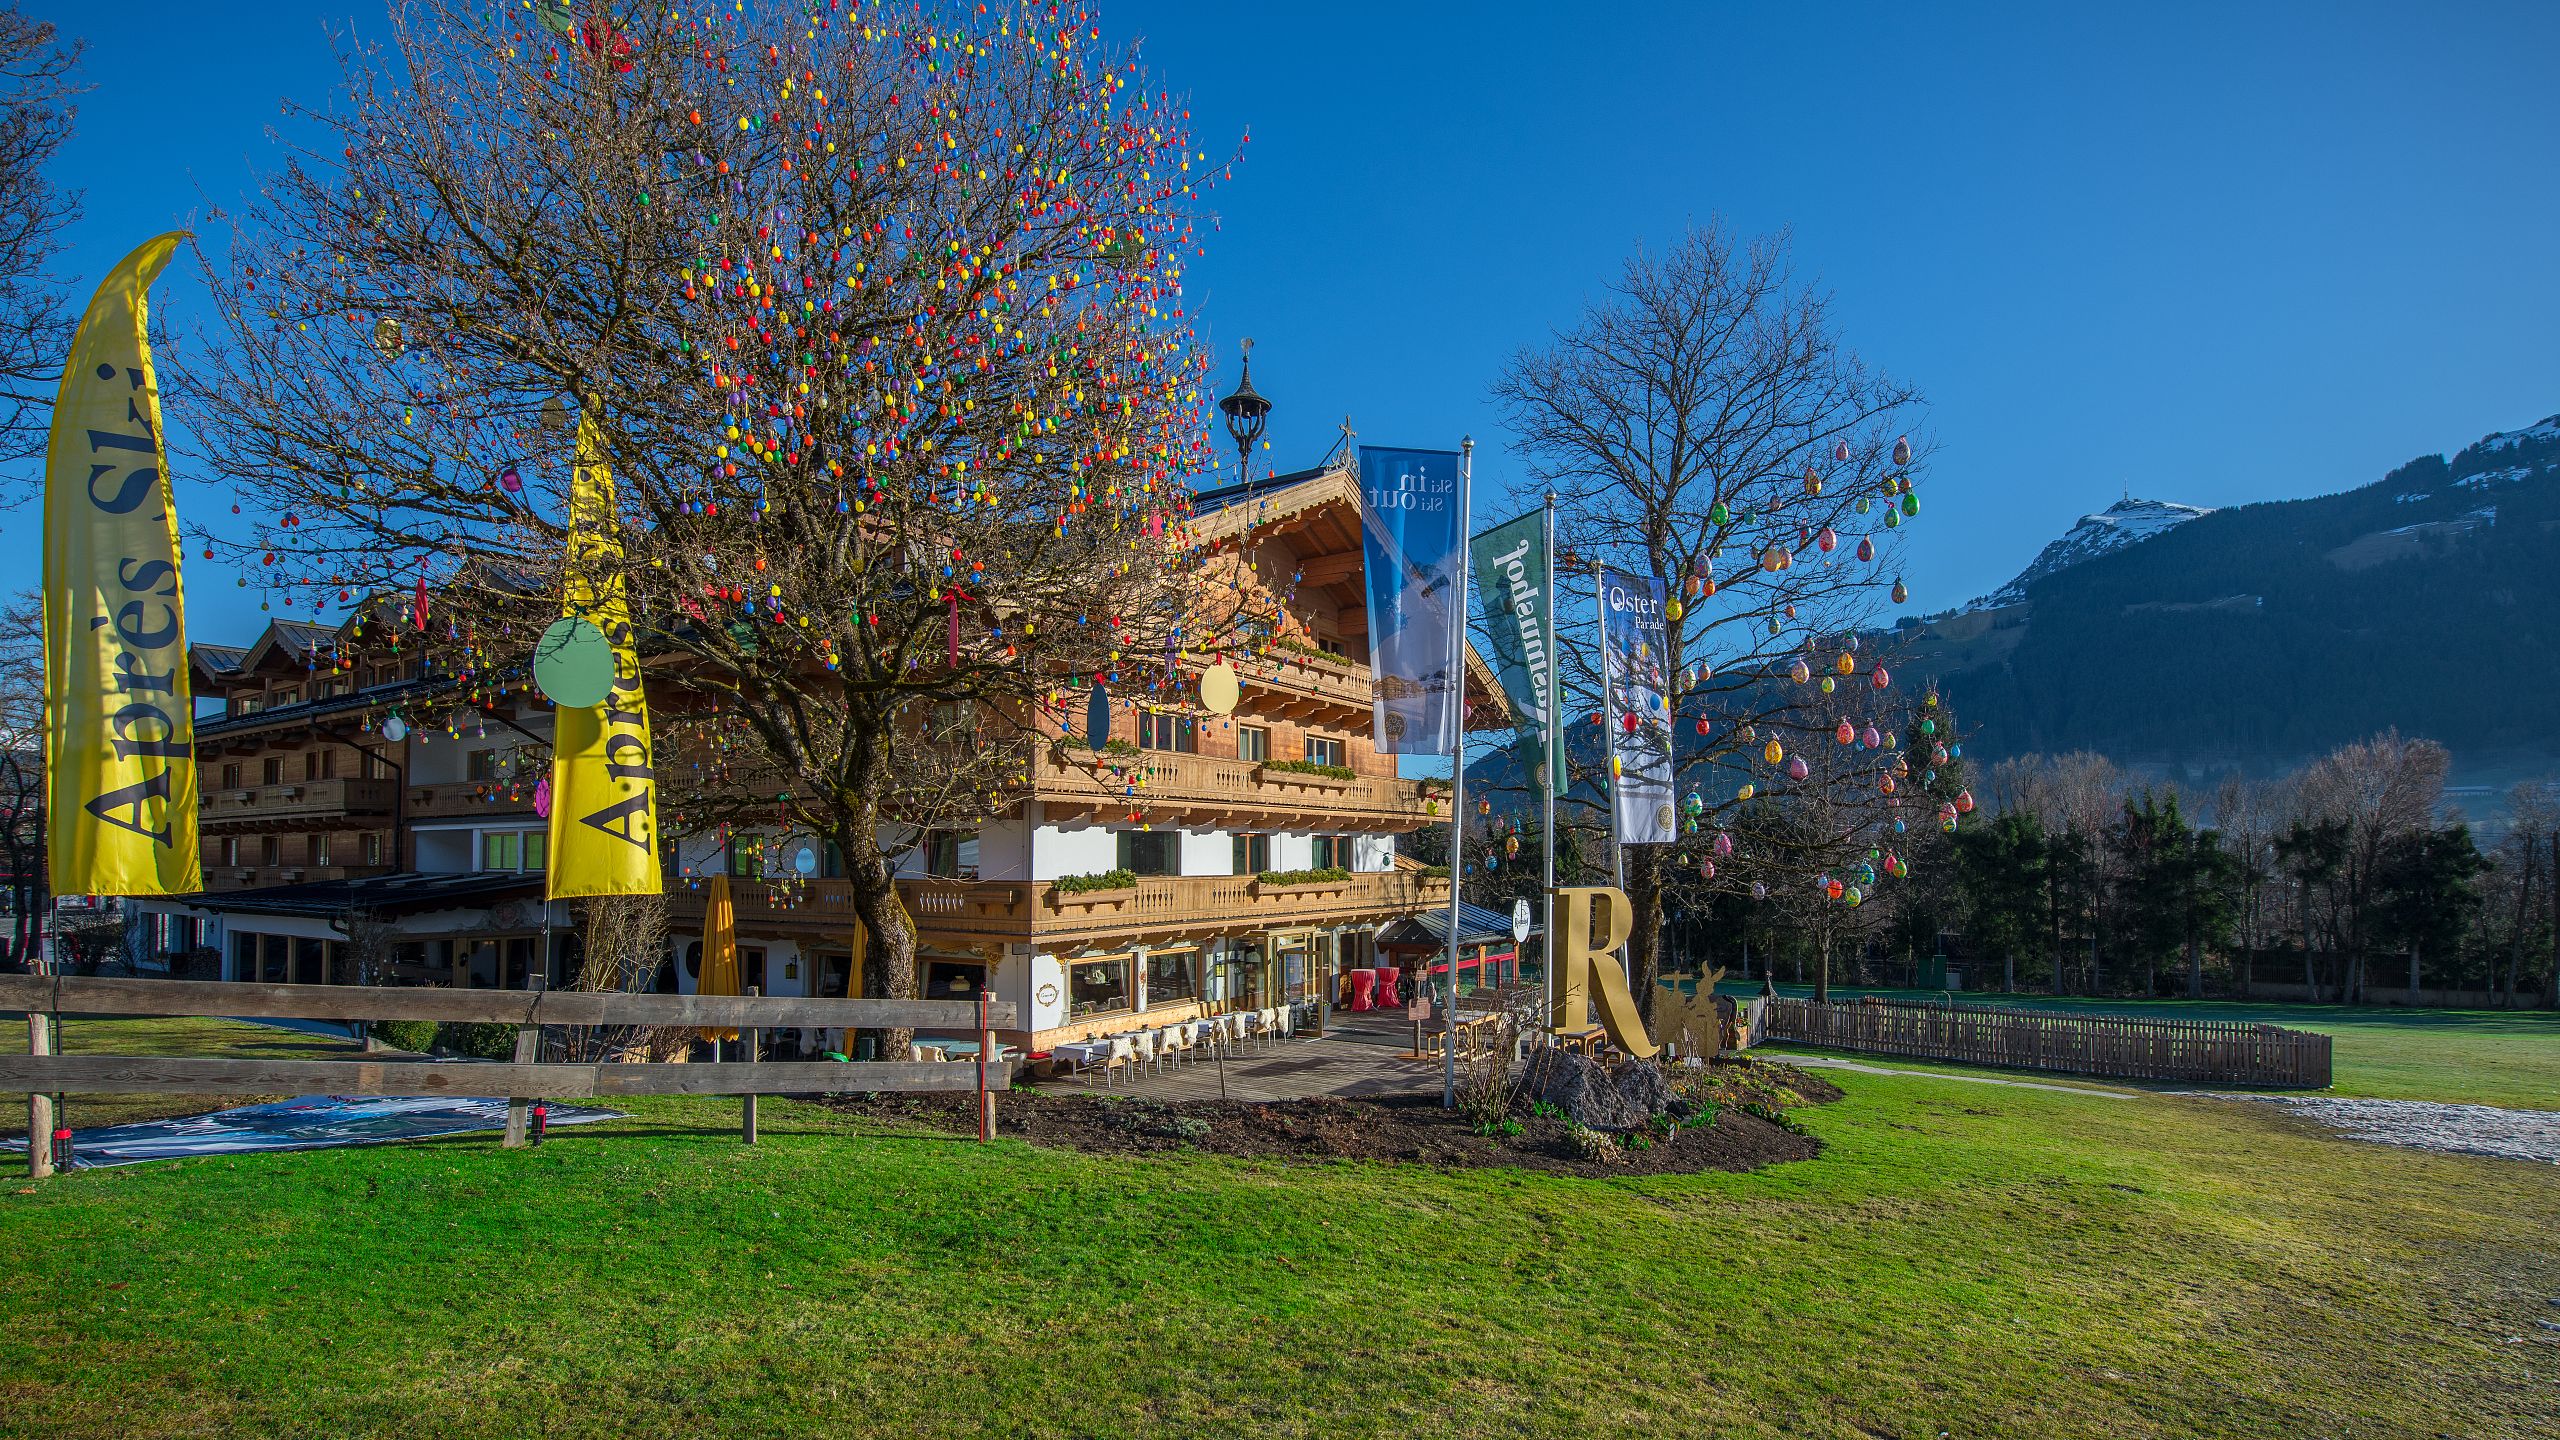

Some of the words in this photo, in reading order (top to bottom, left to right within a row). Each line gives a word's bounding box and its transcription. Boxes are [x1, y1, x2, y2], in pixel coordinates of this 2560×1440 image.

[1610, 586, 1658, 615] Oster
[1635, 616, 1665, 631] Parade
[85, 557, 192, 850] Après
[1543, 886, 1661, 1059] R
